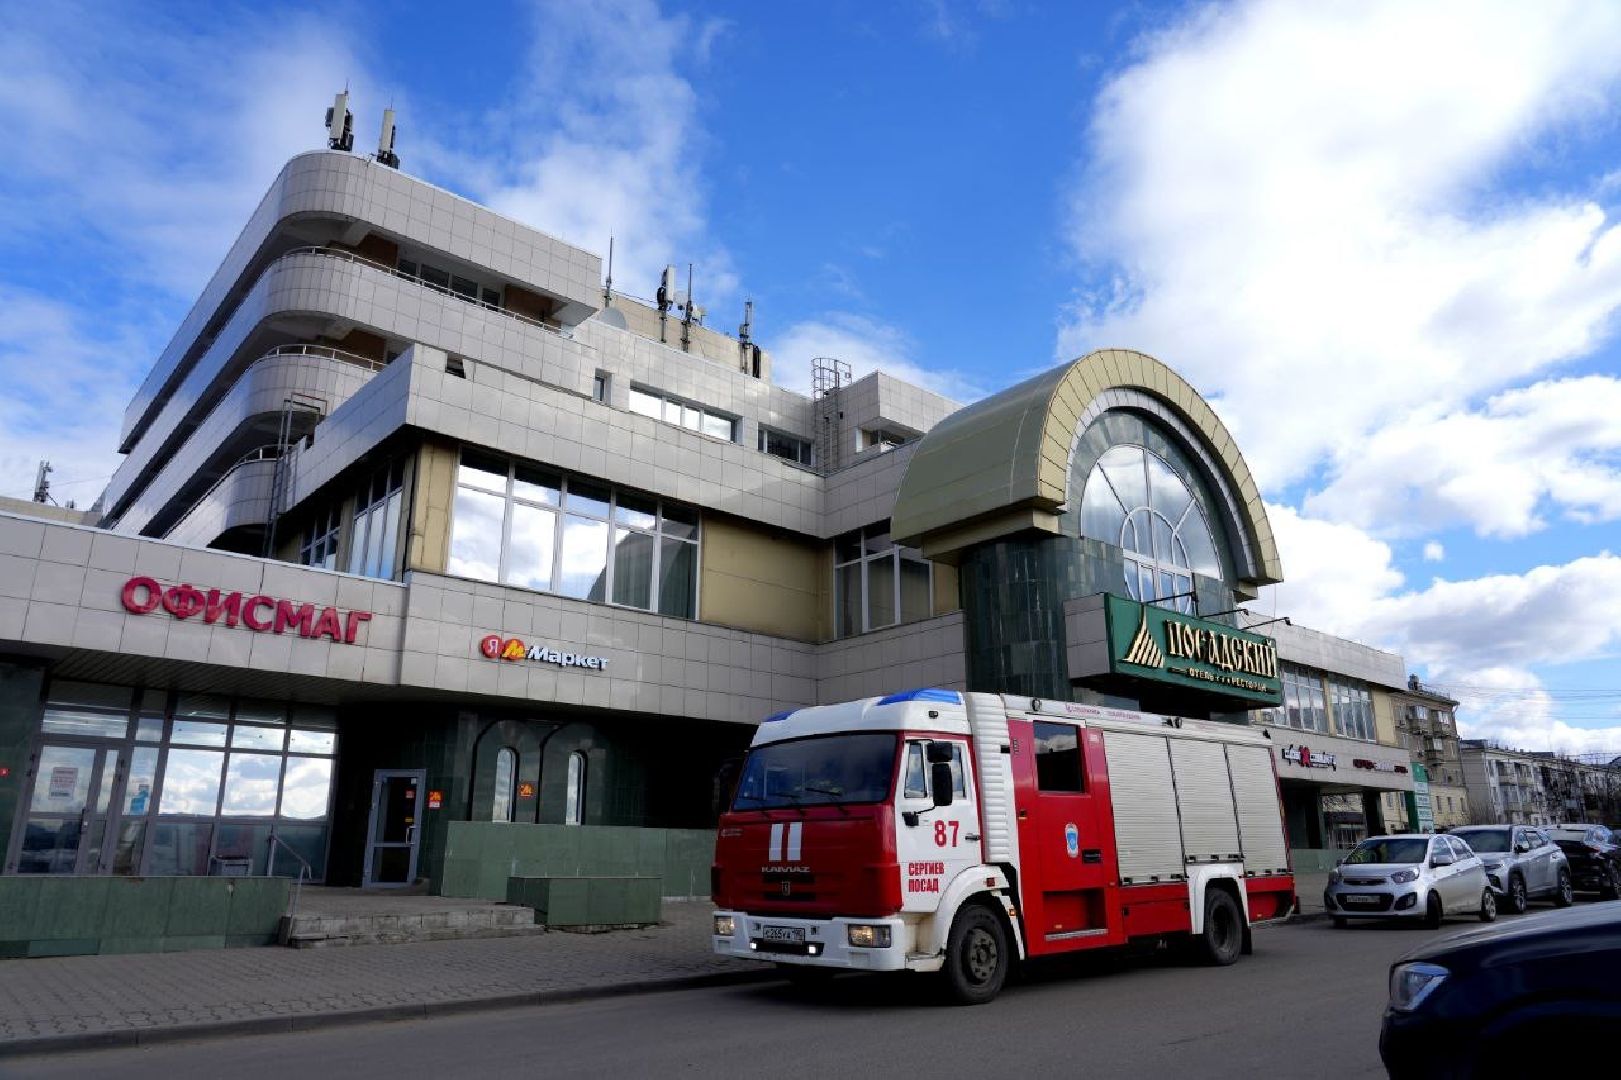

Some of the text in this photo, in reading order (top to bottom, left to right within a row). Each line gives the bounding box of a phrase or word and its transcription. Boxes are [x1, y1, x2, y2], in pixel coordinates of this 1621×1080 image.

[121, 576, 372, 644] ОФИСМАГ
[527, 645, 610, 671] Маркет
[934, 820, 959, 848] 87
[908, 862, 945, 877] СЕРГИЕВ
[908, 878, 939, 893] ПОСАД
